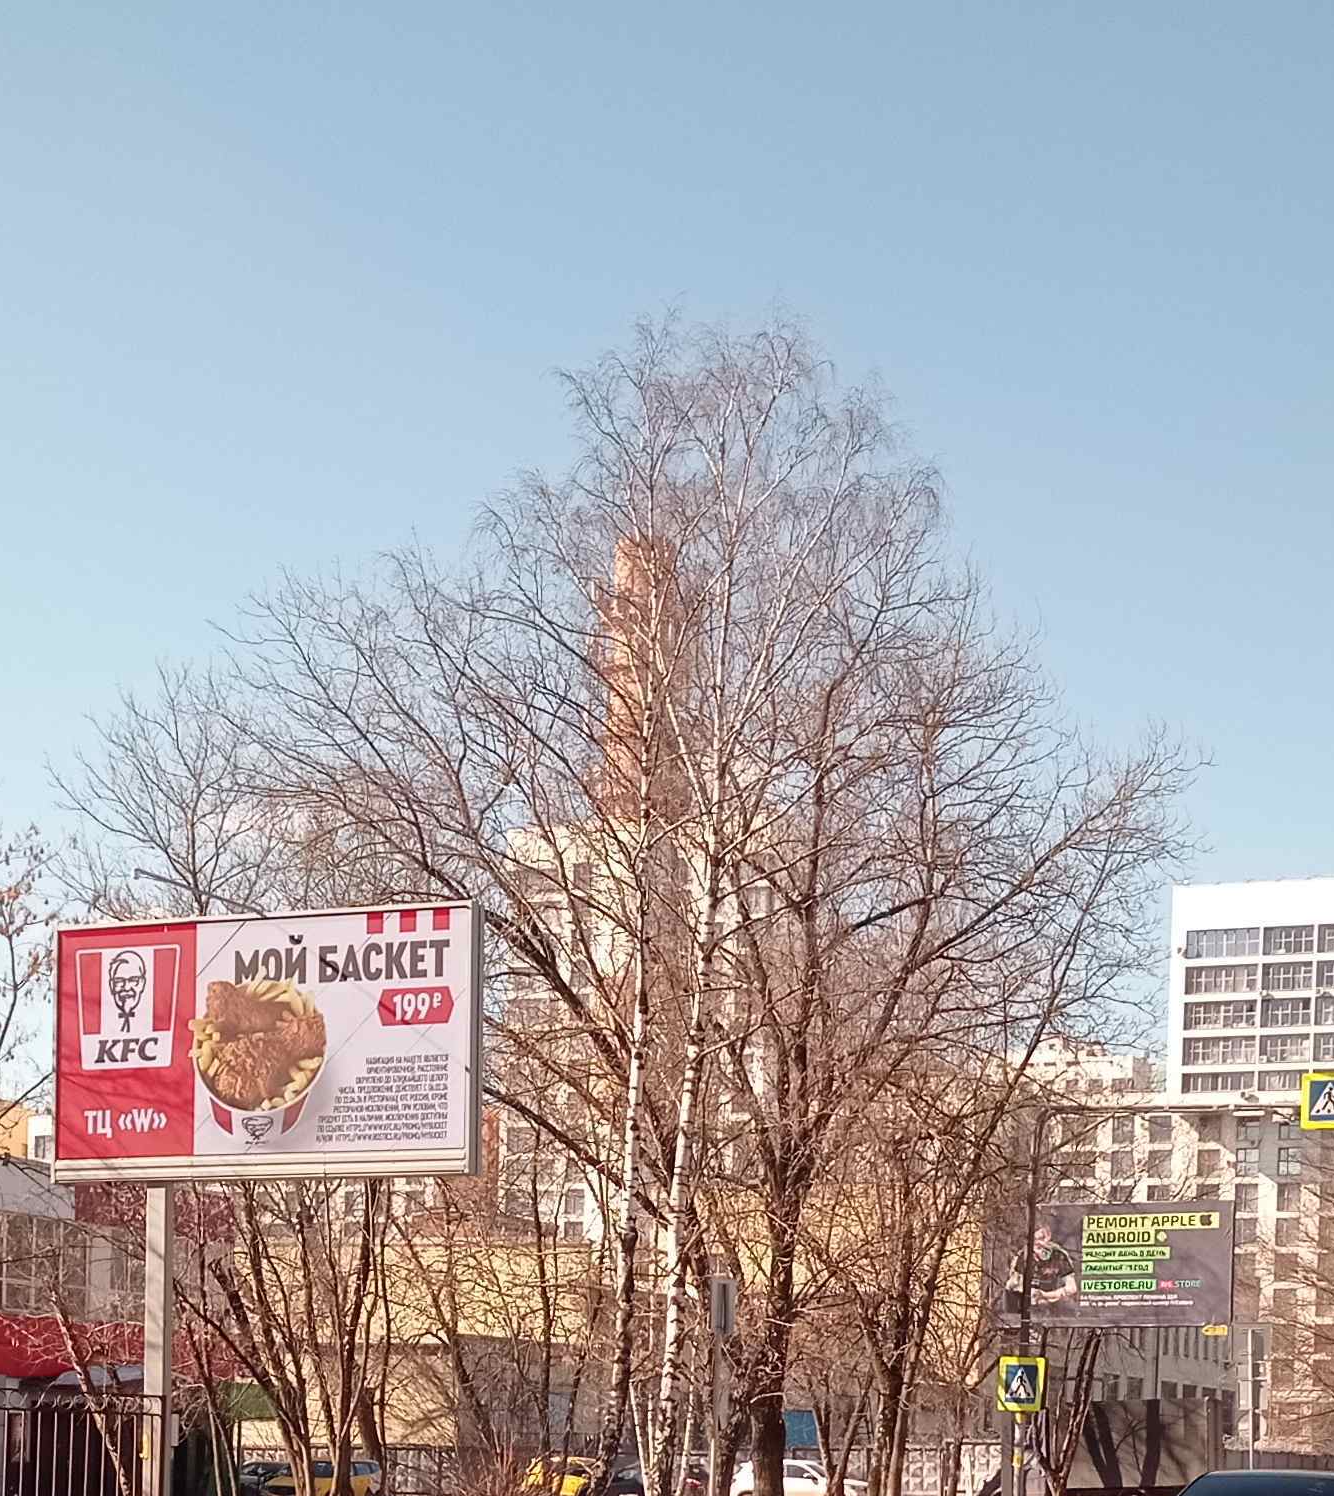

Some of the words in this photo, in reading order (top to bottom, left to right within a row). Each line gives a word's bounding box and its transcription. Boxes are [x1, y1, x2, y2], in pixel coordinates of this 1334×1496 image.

[234, 934, 307, 985] МОЙ
[318, 939, 450, 983] БАСКЕТ
[95, 1036, 159, 1063] KFC
[85, 1110, 113, 1139] ТЦ
[1087, 1216, 1148, 1228] РЕМОНТ
[1151, 1214, 1196, 1227] APPLE
[1086, 1230, 1151, 1244] ANDROID
[1083, 1280, 1154, 1290] IVESTORE.RU
